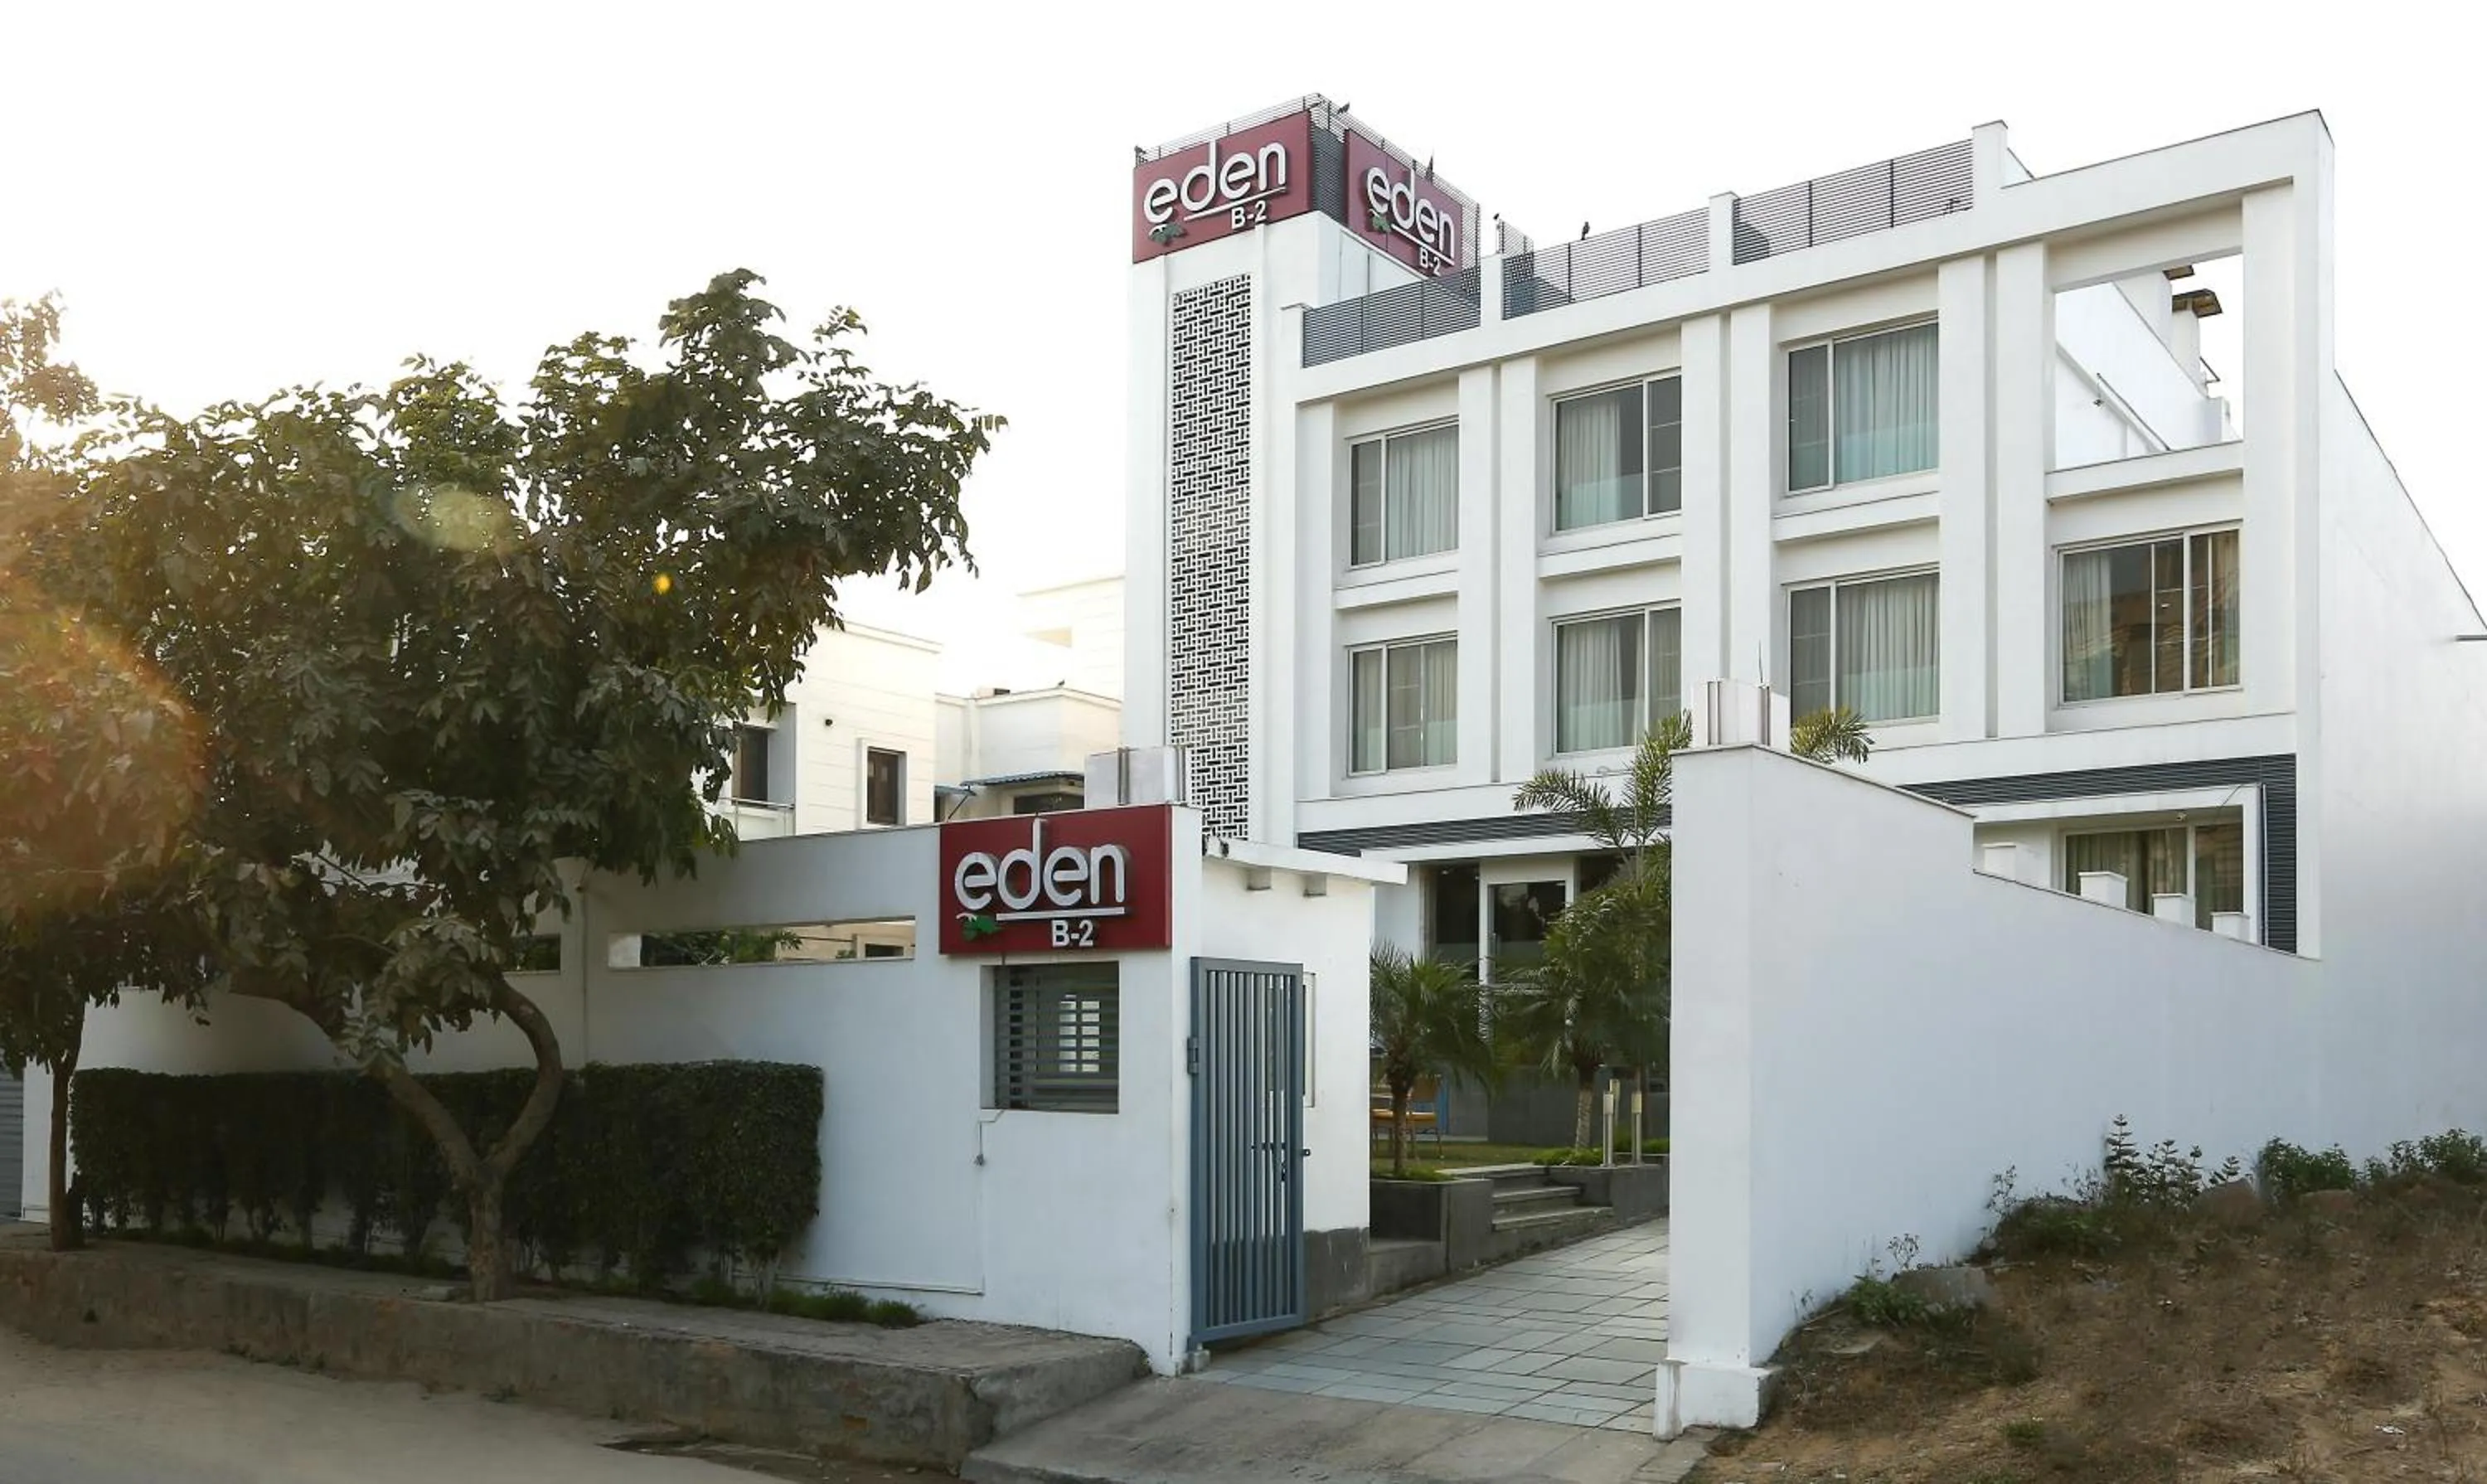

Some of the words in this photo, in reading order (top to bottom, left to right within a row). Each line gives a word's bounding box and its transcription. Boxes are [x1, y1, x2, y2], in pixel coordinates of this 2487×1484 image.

[1144, 139, 1287, 223] eden
[1367, 160, 1456, 259] eden
[1231, 200, 1268, 230] B-2
[1418, 250, 1442, 276] B-2
[955, 818, 1125, 910] eden
[1051, 920, 1094, 948] B-2
